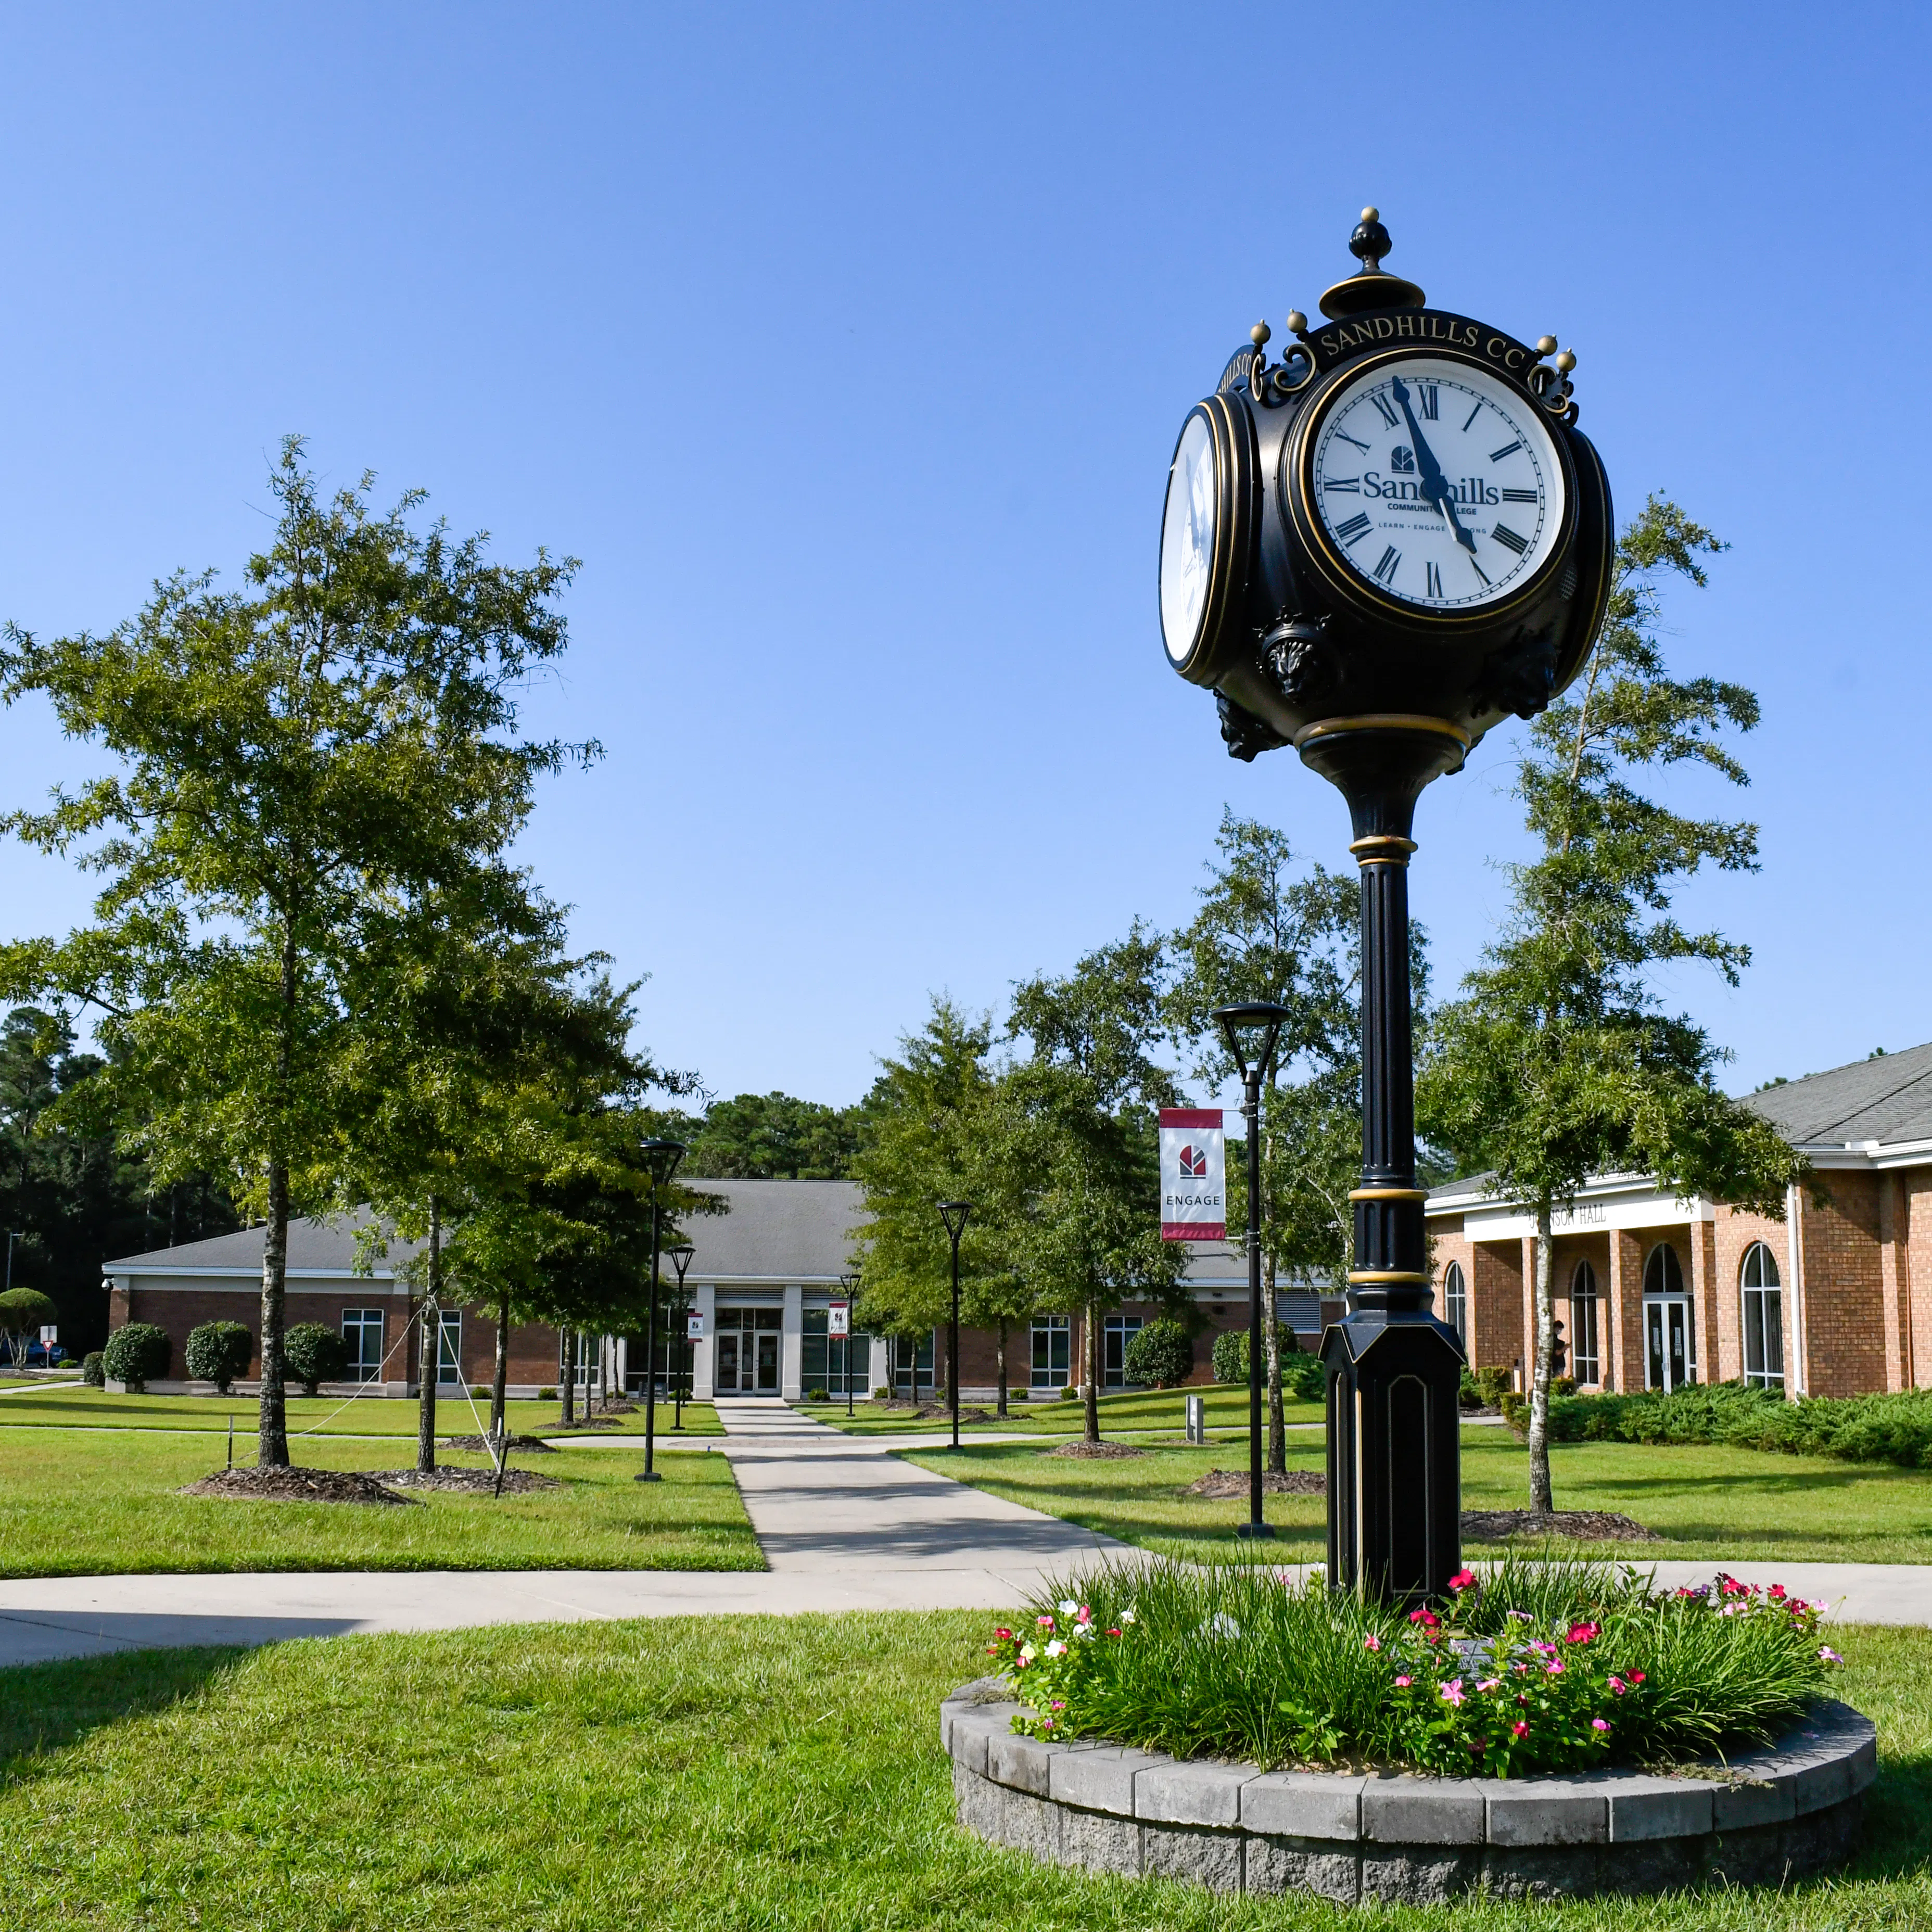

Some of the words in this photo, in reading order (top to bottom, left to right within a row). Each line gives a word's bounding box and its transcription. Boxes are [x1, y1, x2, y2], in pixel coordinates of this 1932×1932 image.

[1321, 315, 1479, 356] SANDHILLS
[1486, 337, 1526, 368] CC
[1218, 355, 1241, 393] HILLS
[1368, 392, 1401, 431] XI
[1417, 385, 1440, 421] XII
[1334, 427, 1371, 456] X
[1489, 440, 1523, 463] II
[1324, 476, 1360, 494] IX
[1364, 472, 1499, 505] Sanills
[1503, 488, 1537, 504] III
[1388, 503, 1433, 513] COMMUNIT
[1457, 507, 1477, 515] LEGE
[1334, 511, 1375, 548] VIII
[1490, 522, 1530, 555] IIII
[1372, 544, 1402, 585] VII
[1425, 562, 1445, 598] VI
[1469, 555, 1493, 589] V
[1166, 1195, 1220, 1205] ENGAGE
[1529, 1208, 1574, 1229] JNSON
[1579, 1203, 1606, 1225] HALL
